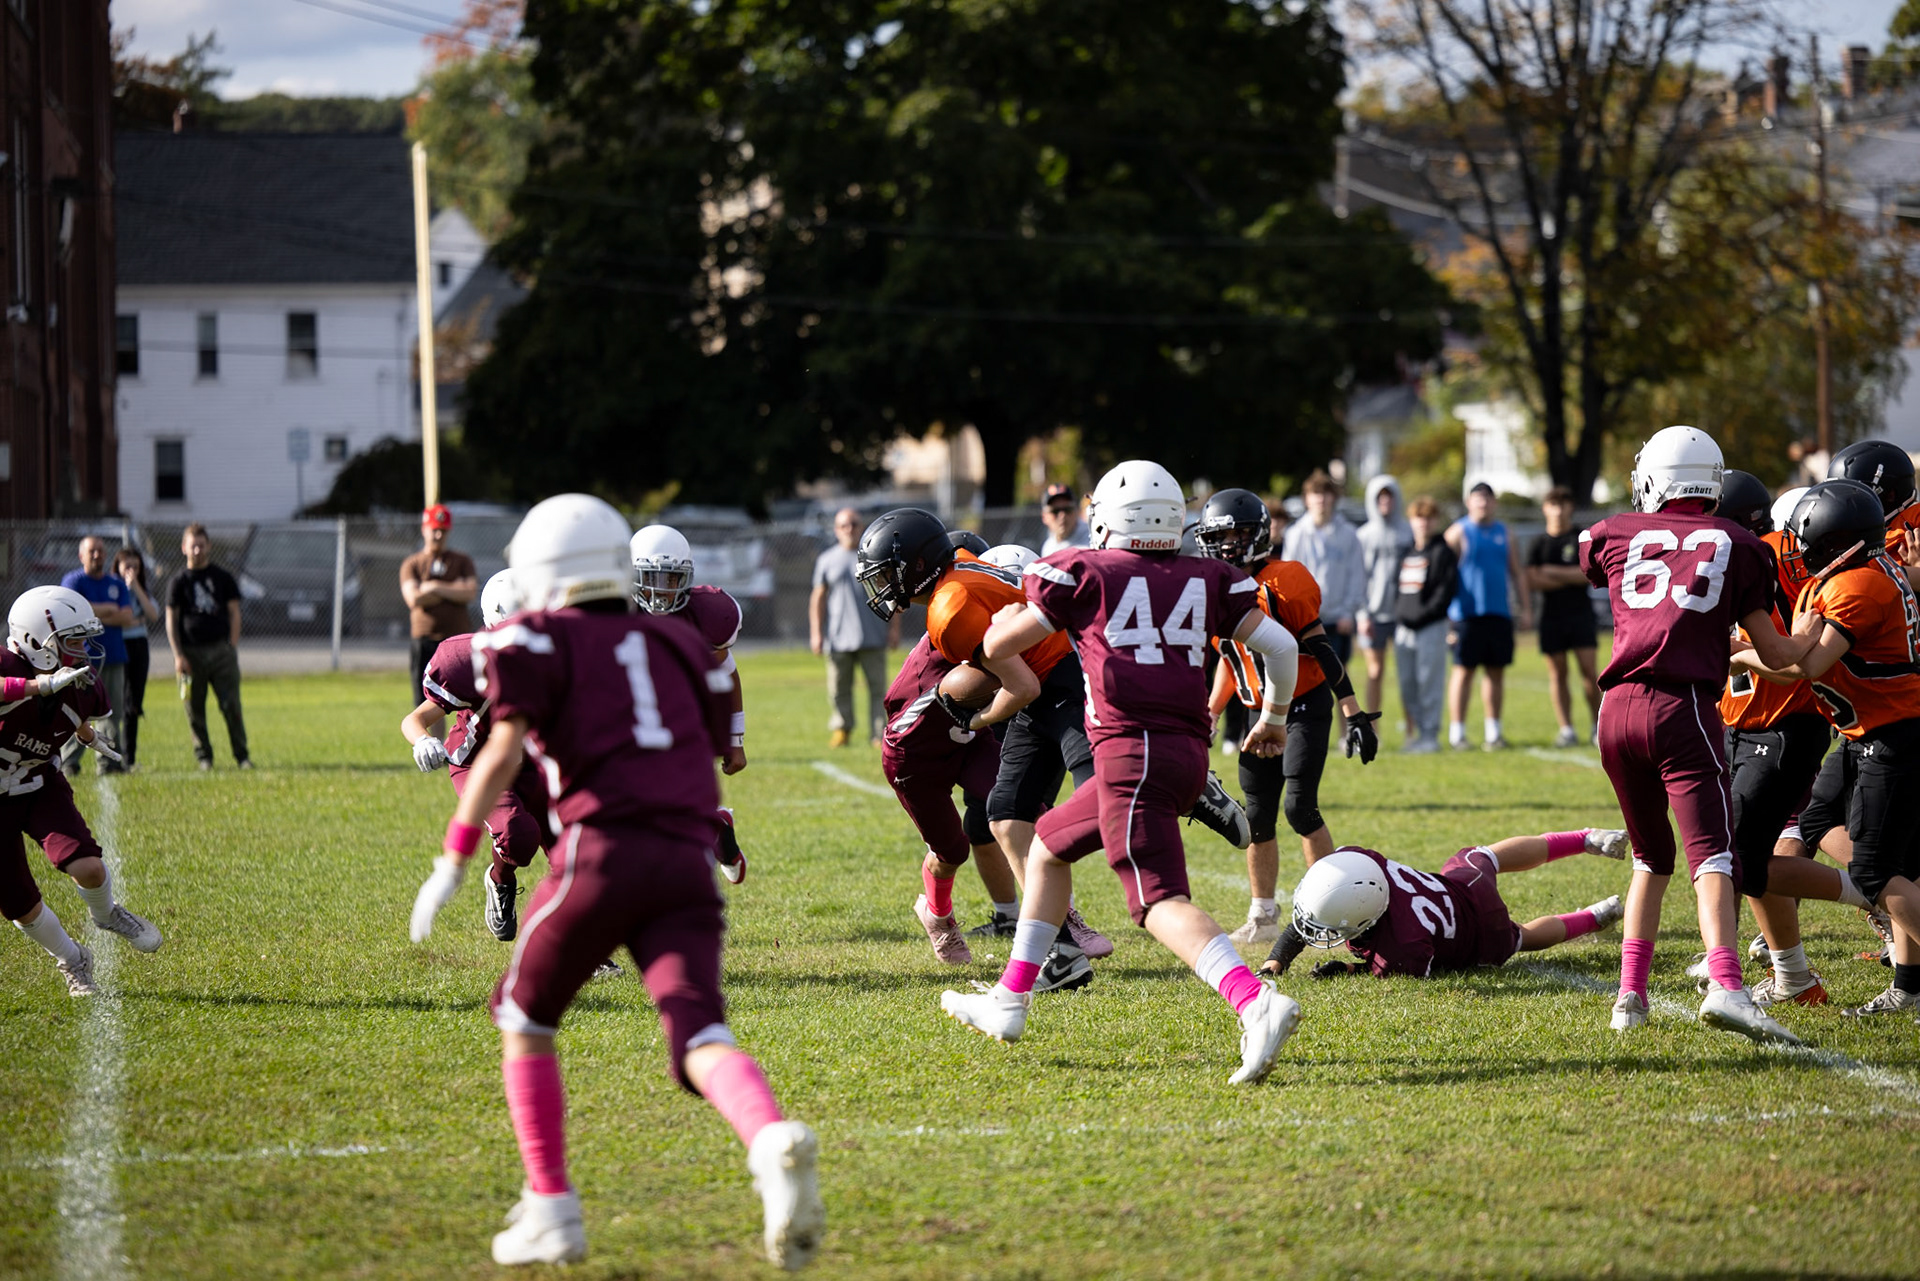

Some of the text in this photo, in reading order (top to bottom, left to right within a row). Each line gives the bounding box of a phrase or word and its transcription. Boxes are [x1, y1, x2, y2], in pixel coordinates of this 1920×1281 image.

[1683, 485, 1713, 495] schutt
[1130, 539, 1175, 549] Riddell
[1621, 529, 1732, 613] 63
[1103, 576, 1207, 668] 44
[613, 630, 674, 750] 1
[1218, 638, 1266, 706] 11
[14, 732, 52, 756] RAMS
[1386, 859, 1457, 940] 22
